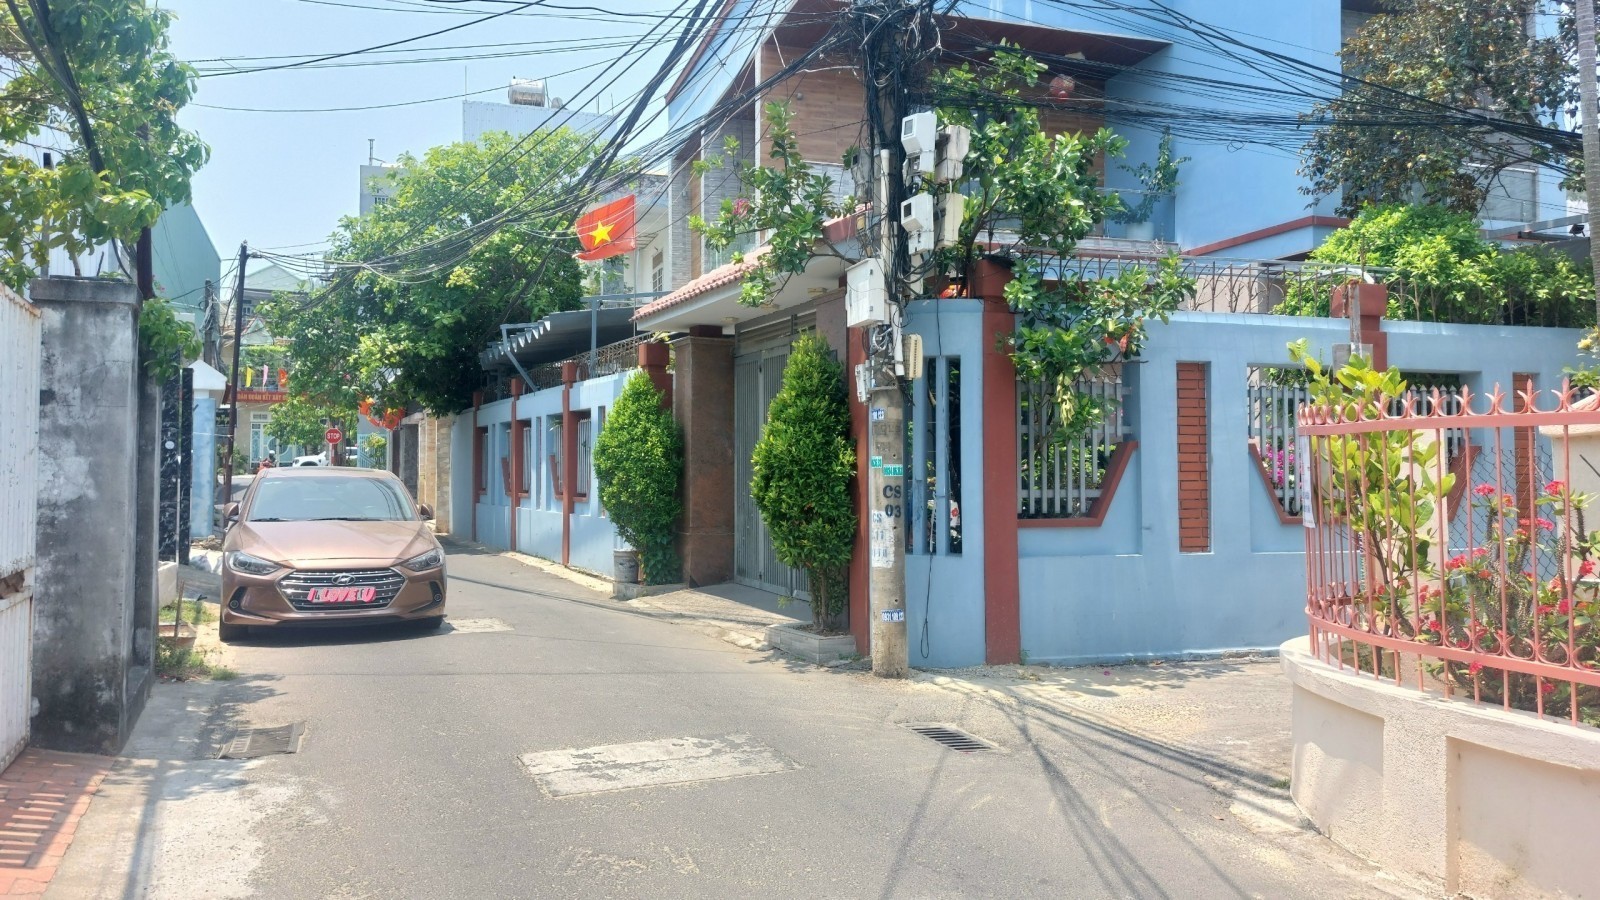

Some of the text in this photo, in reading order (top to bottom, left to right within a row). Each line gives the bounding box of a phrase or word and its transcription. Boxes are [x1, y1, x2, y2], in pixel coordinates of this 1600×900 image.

[327, 432, 340, 440] STOP
[882, 485, 902, 499] CS
[884, 504, 901, 518] 03
[322, 587, 358, 602] LOVE
[362, 587, 376, 603] U
